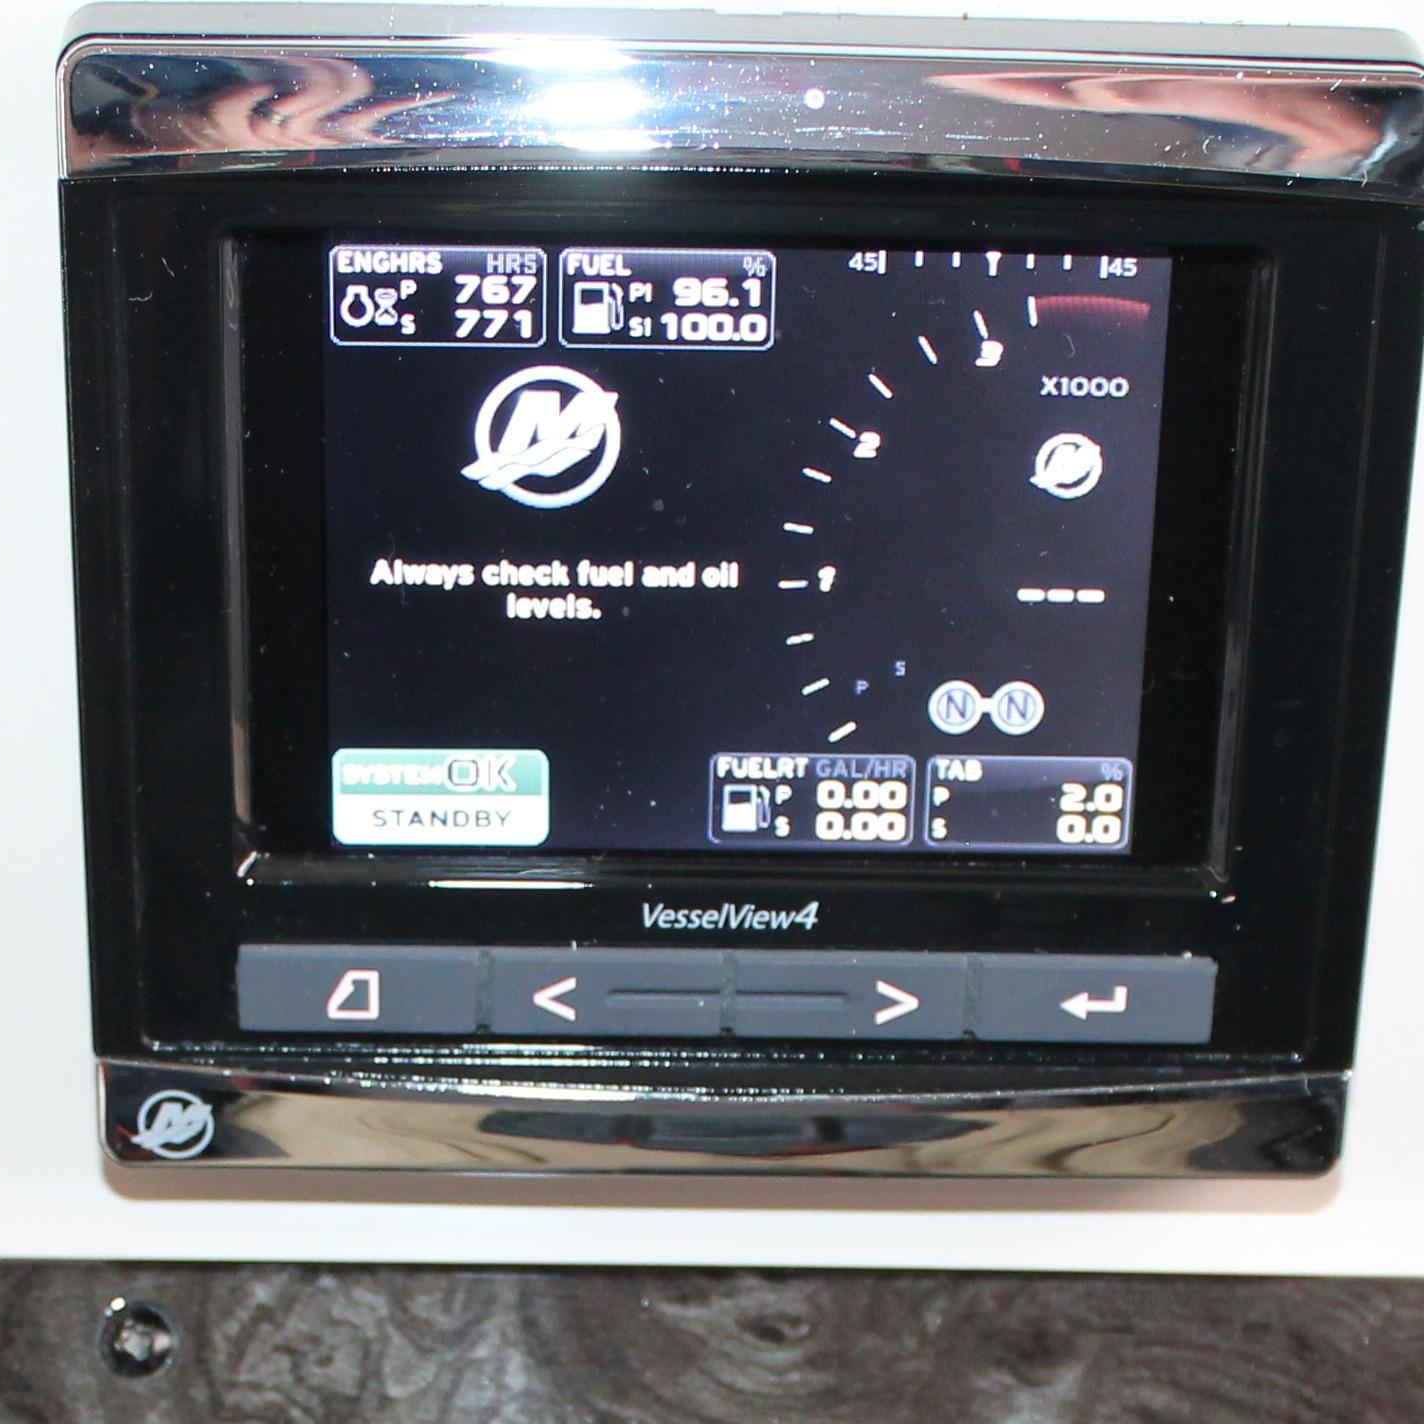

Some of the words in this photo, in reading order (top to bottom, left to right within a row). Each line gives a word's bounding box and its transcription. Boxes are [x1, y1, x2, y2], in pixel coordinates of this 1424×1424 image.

[337, 251, 443, 275] ENGHRS
[487, 253, 537, 274] HRS
[567, 254, 632, 277] FUEL
[848, 253, 878, 272] 45
[1108, 257, 1138, 277] 45
[400, 280, 418, 299] P
[454, 275, 537, 304] 767
[673, 277, 763, 307] 96.1
[400, 314, 417, 334] S
[454, 309, 534, 338] 771
[660, 313, 768, 342] 100.0
[975, 339, 1004, 367] 3
[853, 431, 881, 458] 2
[369, 558, 475, 590] Always
[481, 559, 571, 588] check
[576, 560, 634, 588] fuel
[640, 560, 697, 588] and
[701, 560, 740, 588] oil
[817, 564, 837, 592] 1
[506, 592, 602, 619] levels.
[944, 687, 967, 722] N
[1006, 688, 1028, 722] N
[444, 754, 518, 791] OK
[716, 757, 810, 780] FUELRT
[815, 758, 908, 779] GAL/HR
[935, 760, 983, 781] TAB
[775, 784, 793, 805] P
[815, 780, 908, 809] 0.00
[933, 786, 950, 807] P
[1059, 783, 1123, 812] 2.0
[372, 809, 512, 828] STANDBY
[774, 815, 791, 838] S
[814, 811, 907, 841] 0.00
[931, 817, 947, 839] S
[1056, 814, 1122, 843] 0.0
[641, 901, 820, 931] VesselView4
